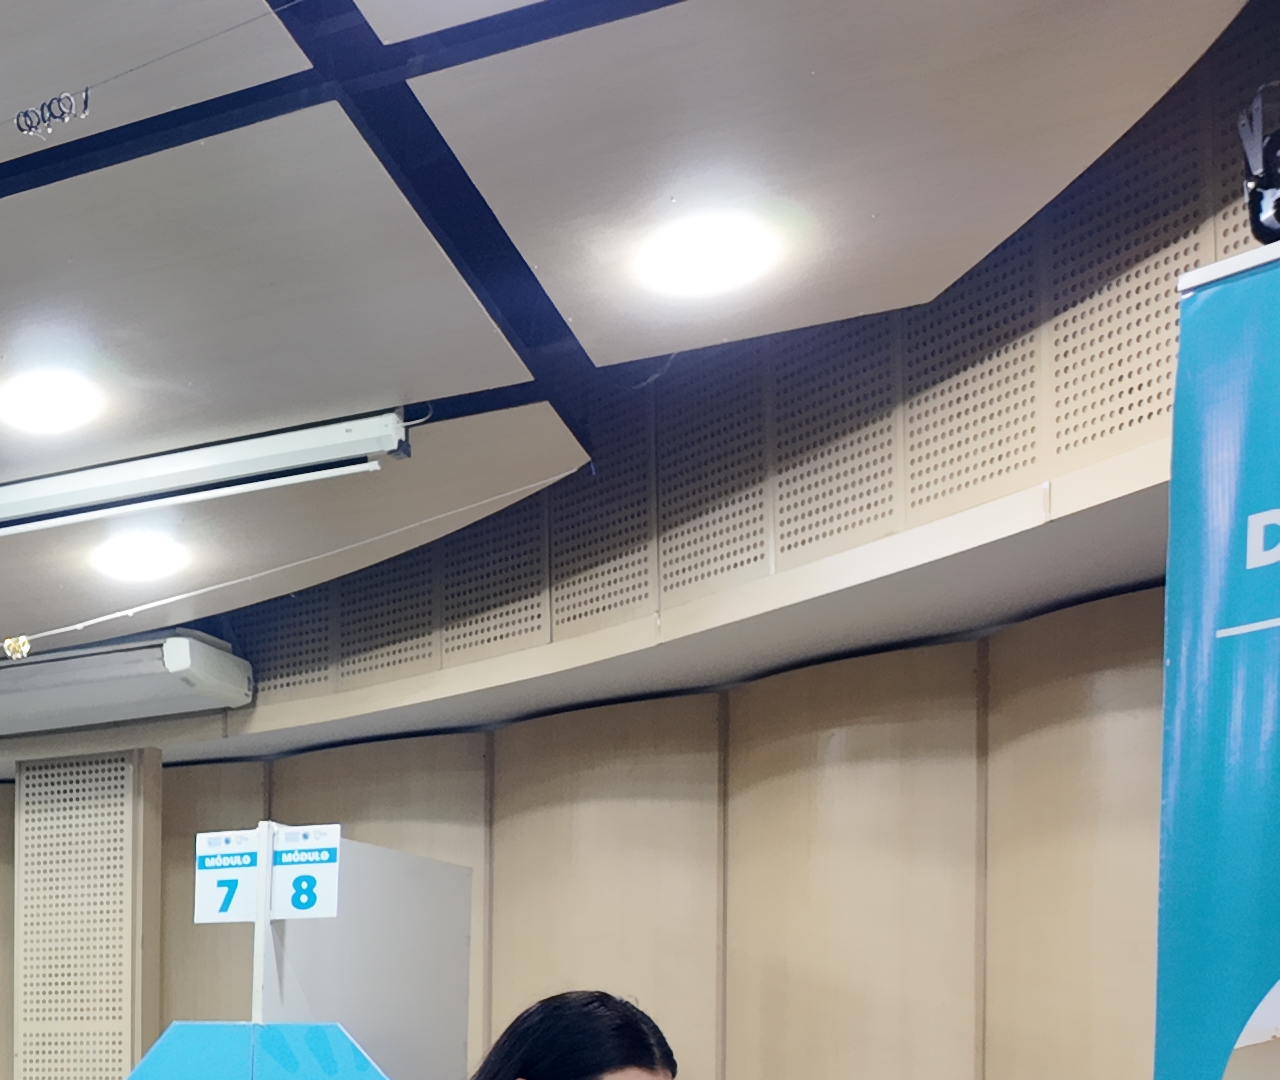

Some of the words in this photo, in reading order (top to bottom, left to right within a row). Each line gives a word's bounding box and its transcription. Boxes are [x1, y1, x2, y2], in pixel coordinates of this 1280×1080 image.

[205, 854, 251, 867] MÓDULO
[281, 849, 330, 863] MÓDULO
[216, 879, 239, 913] 7
[291, 874, 317, 910] 8
